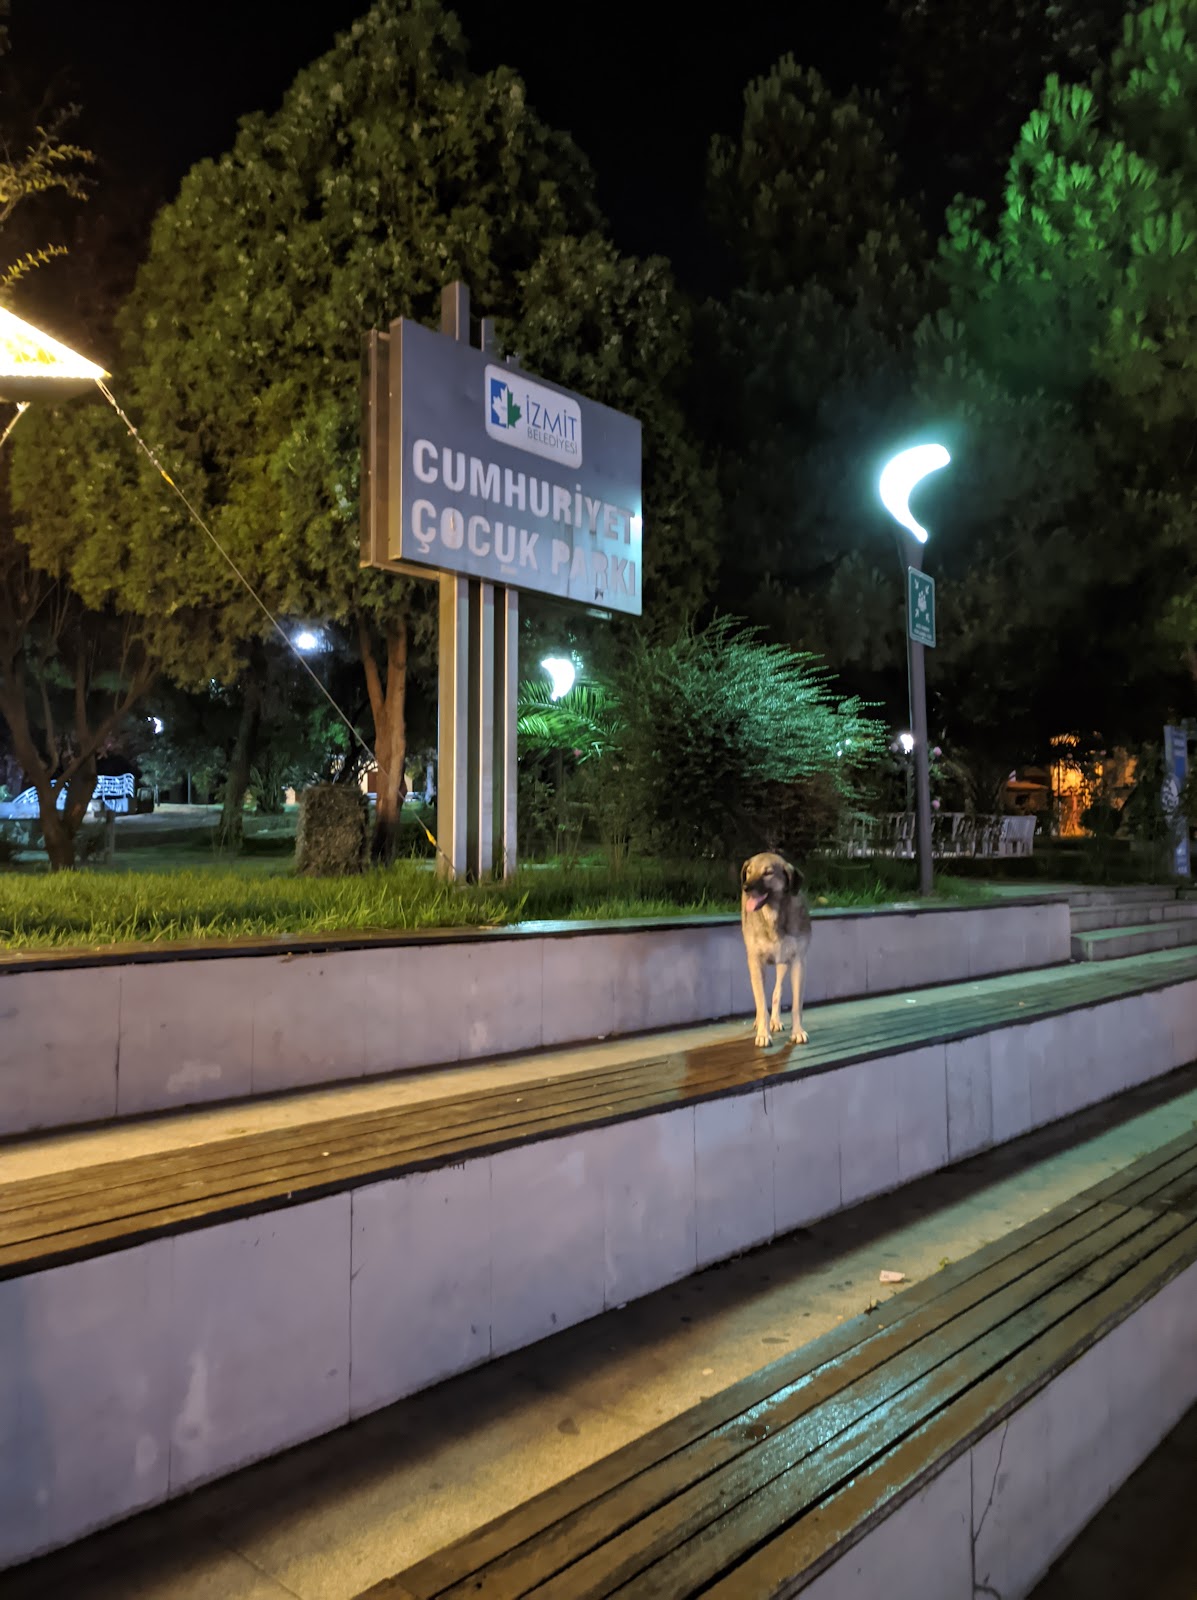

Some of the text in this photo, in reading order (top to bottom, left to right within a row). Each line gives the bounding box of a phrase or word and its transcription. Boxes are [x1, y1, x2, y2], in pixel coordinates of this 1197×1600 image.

[526, 394, 578, 441] İZMİT
[412, 439, 635, 545] CUMHURİYET
[411, 499, 540, 571] ÇOCUK
[551, 539, 636, 596] PARKI
